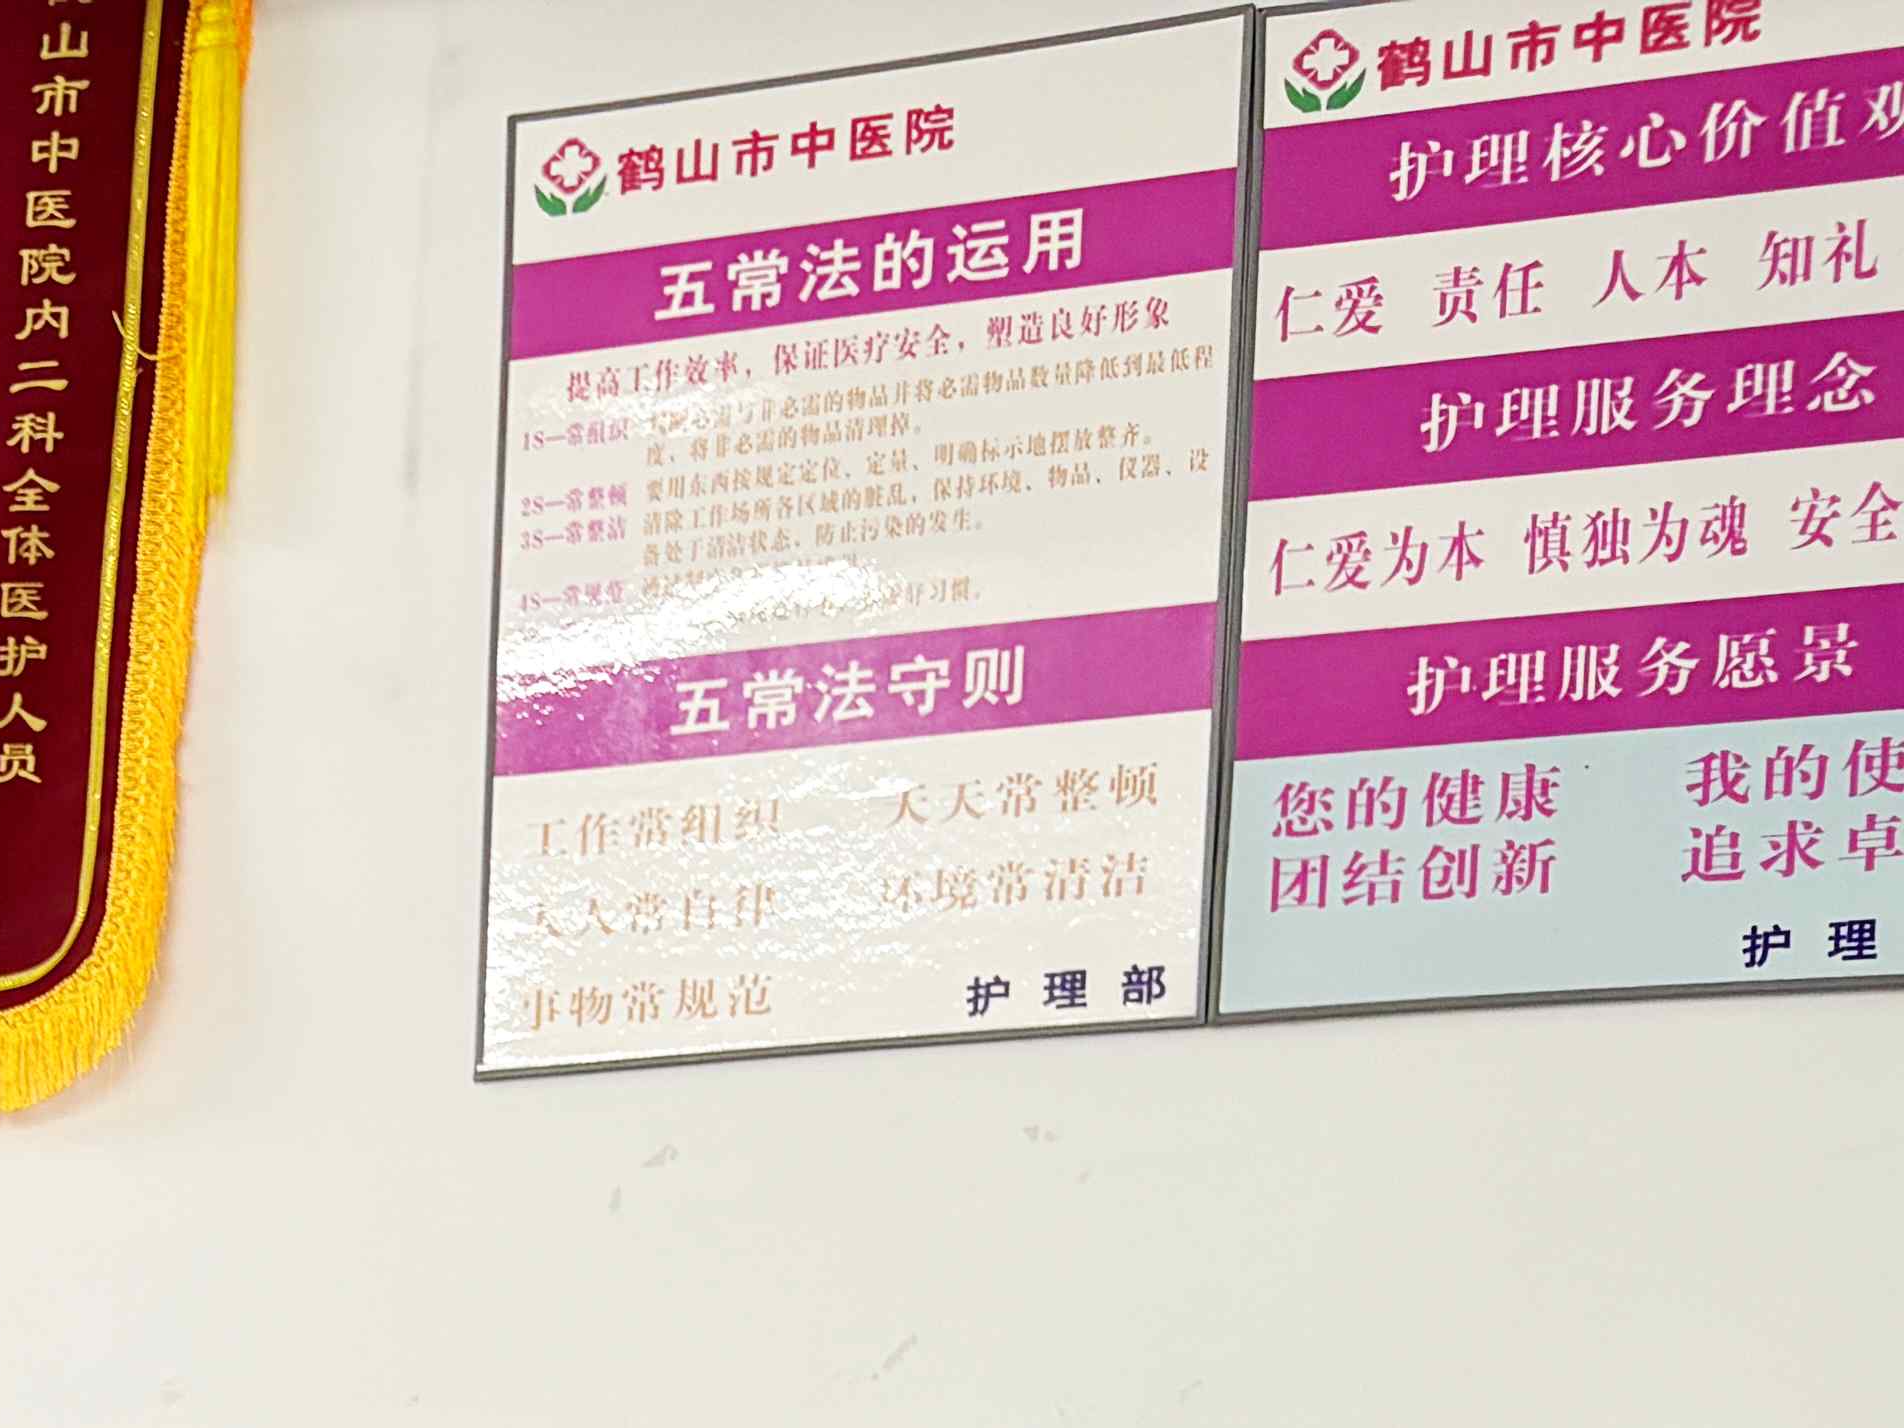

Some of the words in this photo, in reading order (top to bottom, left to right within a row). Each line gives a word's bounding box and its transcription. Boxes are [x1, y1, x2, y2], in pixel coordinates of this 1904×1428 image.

[1375, 0, 1762, 92] 鹤山市中医院
[616, 103, 957, 196] 鹤山市中医院
[653, 206, 1086, 320] 五常法的运用
[1274, 276, 1385, 342] 仁爱
[1431, 260, 1545, 327] 责任
[1592, 239, 1709, 308] 人本
[1755, 218, 1879, 292] 知礼
[1420, 350, 1877, 453] 护理服务理念
[1268, 520, 1486, 597] 仁爱为本
[1524, 495, 1749, 576] 慎独为魂
[1790, 480, 1902, 551] 安全
[669, 643, 1026, 738] 五常法守则
[1406, 622, 1859, 715] 护理服务愿景
[528, 799, 782, 859] 工作常组织
[887, 761, 1161, 827] 天天常整顿
[1272, 762, 1562, 839] 您的健康
[1684, 737, 1904, 807] 我的使
[880, 851, 1149, 912] 环境常清洁
[1269, 837, 1557, 913] 团结创新
[1681, 814, 1904, 885] 追求卓
[1741, 918, 1878, 968] 护理
[520, 972, 773, 1030] 事物常规范
[965, 963, 1167, 1017] 护理部
